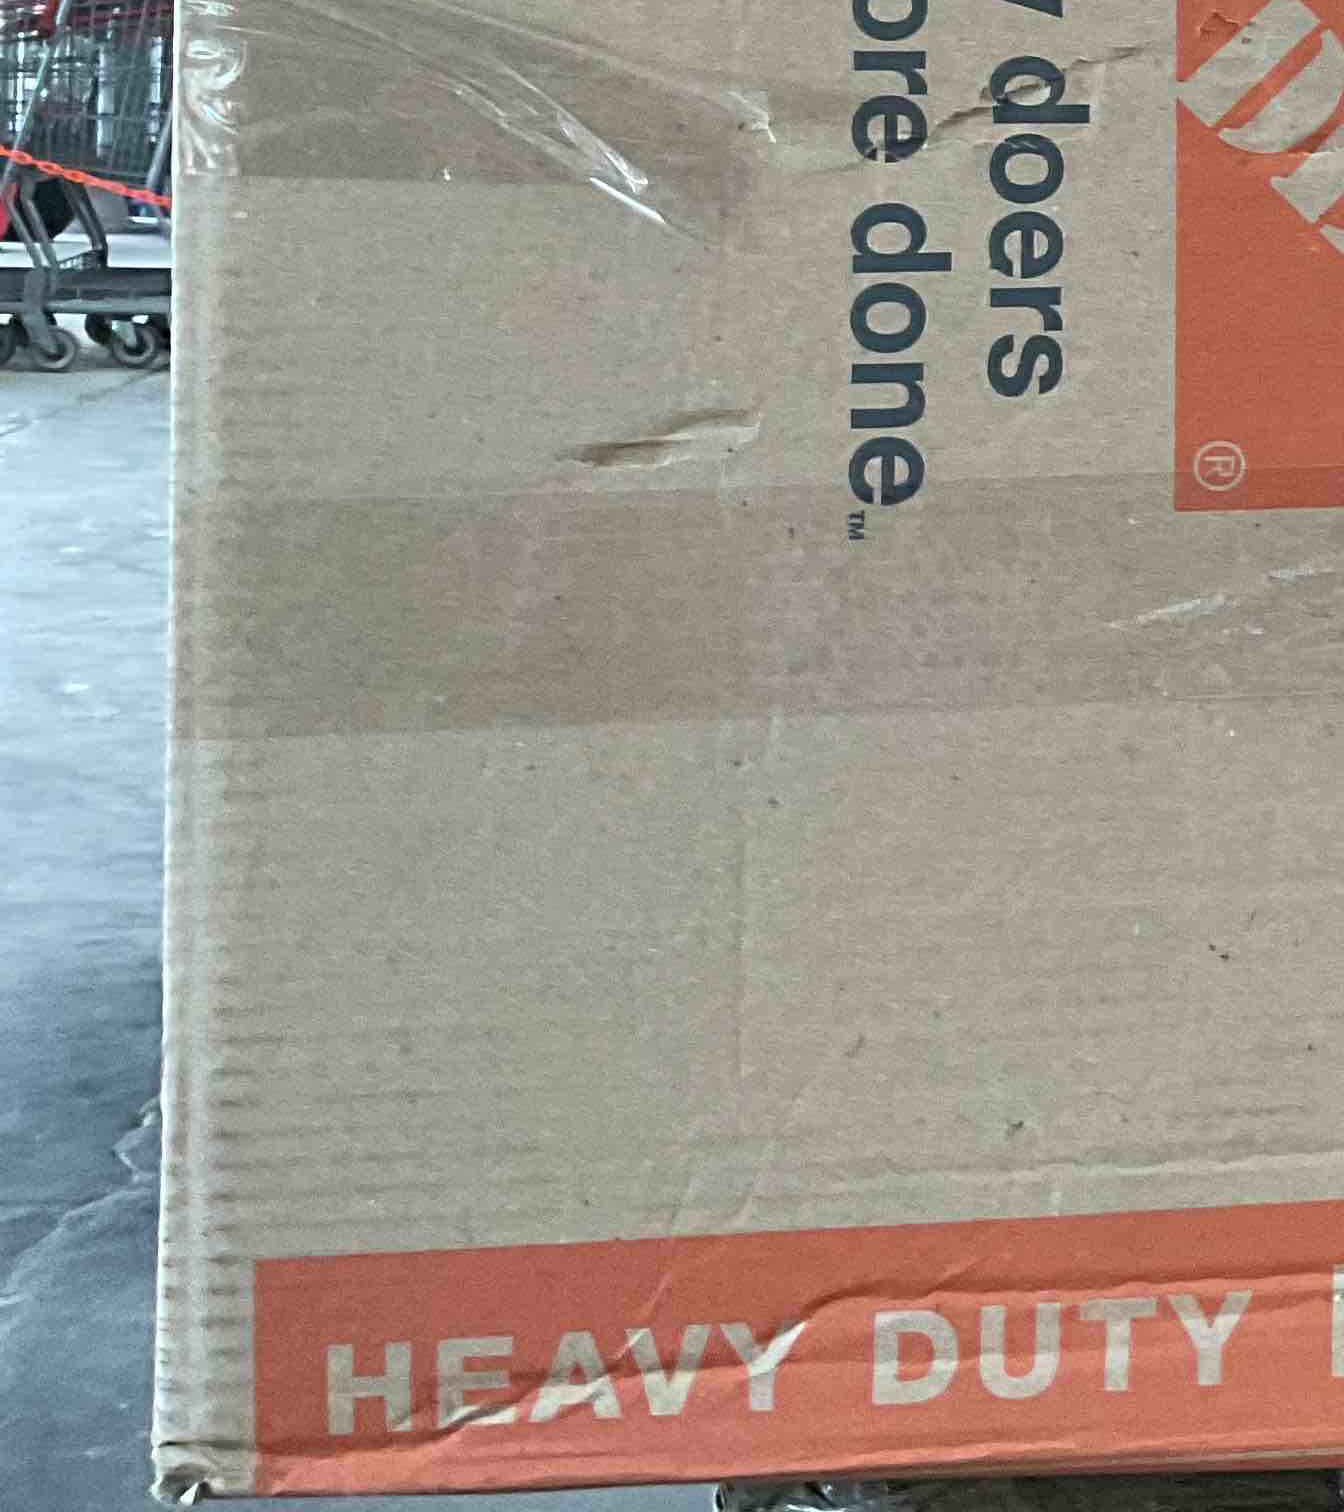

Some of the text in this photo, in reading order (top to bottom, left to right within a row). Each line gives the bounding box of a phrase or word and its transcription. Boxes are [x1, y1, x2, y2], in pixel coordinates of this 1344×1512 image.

[847, 201, 953, 507] done
[986, 54, 1090, 398] doers
[326, 1320, 808, 1436] HEAVY
[871, 1289, 1254, 1407] DUTY
